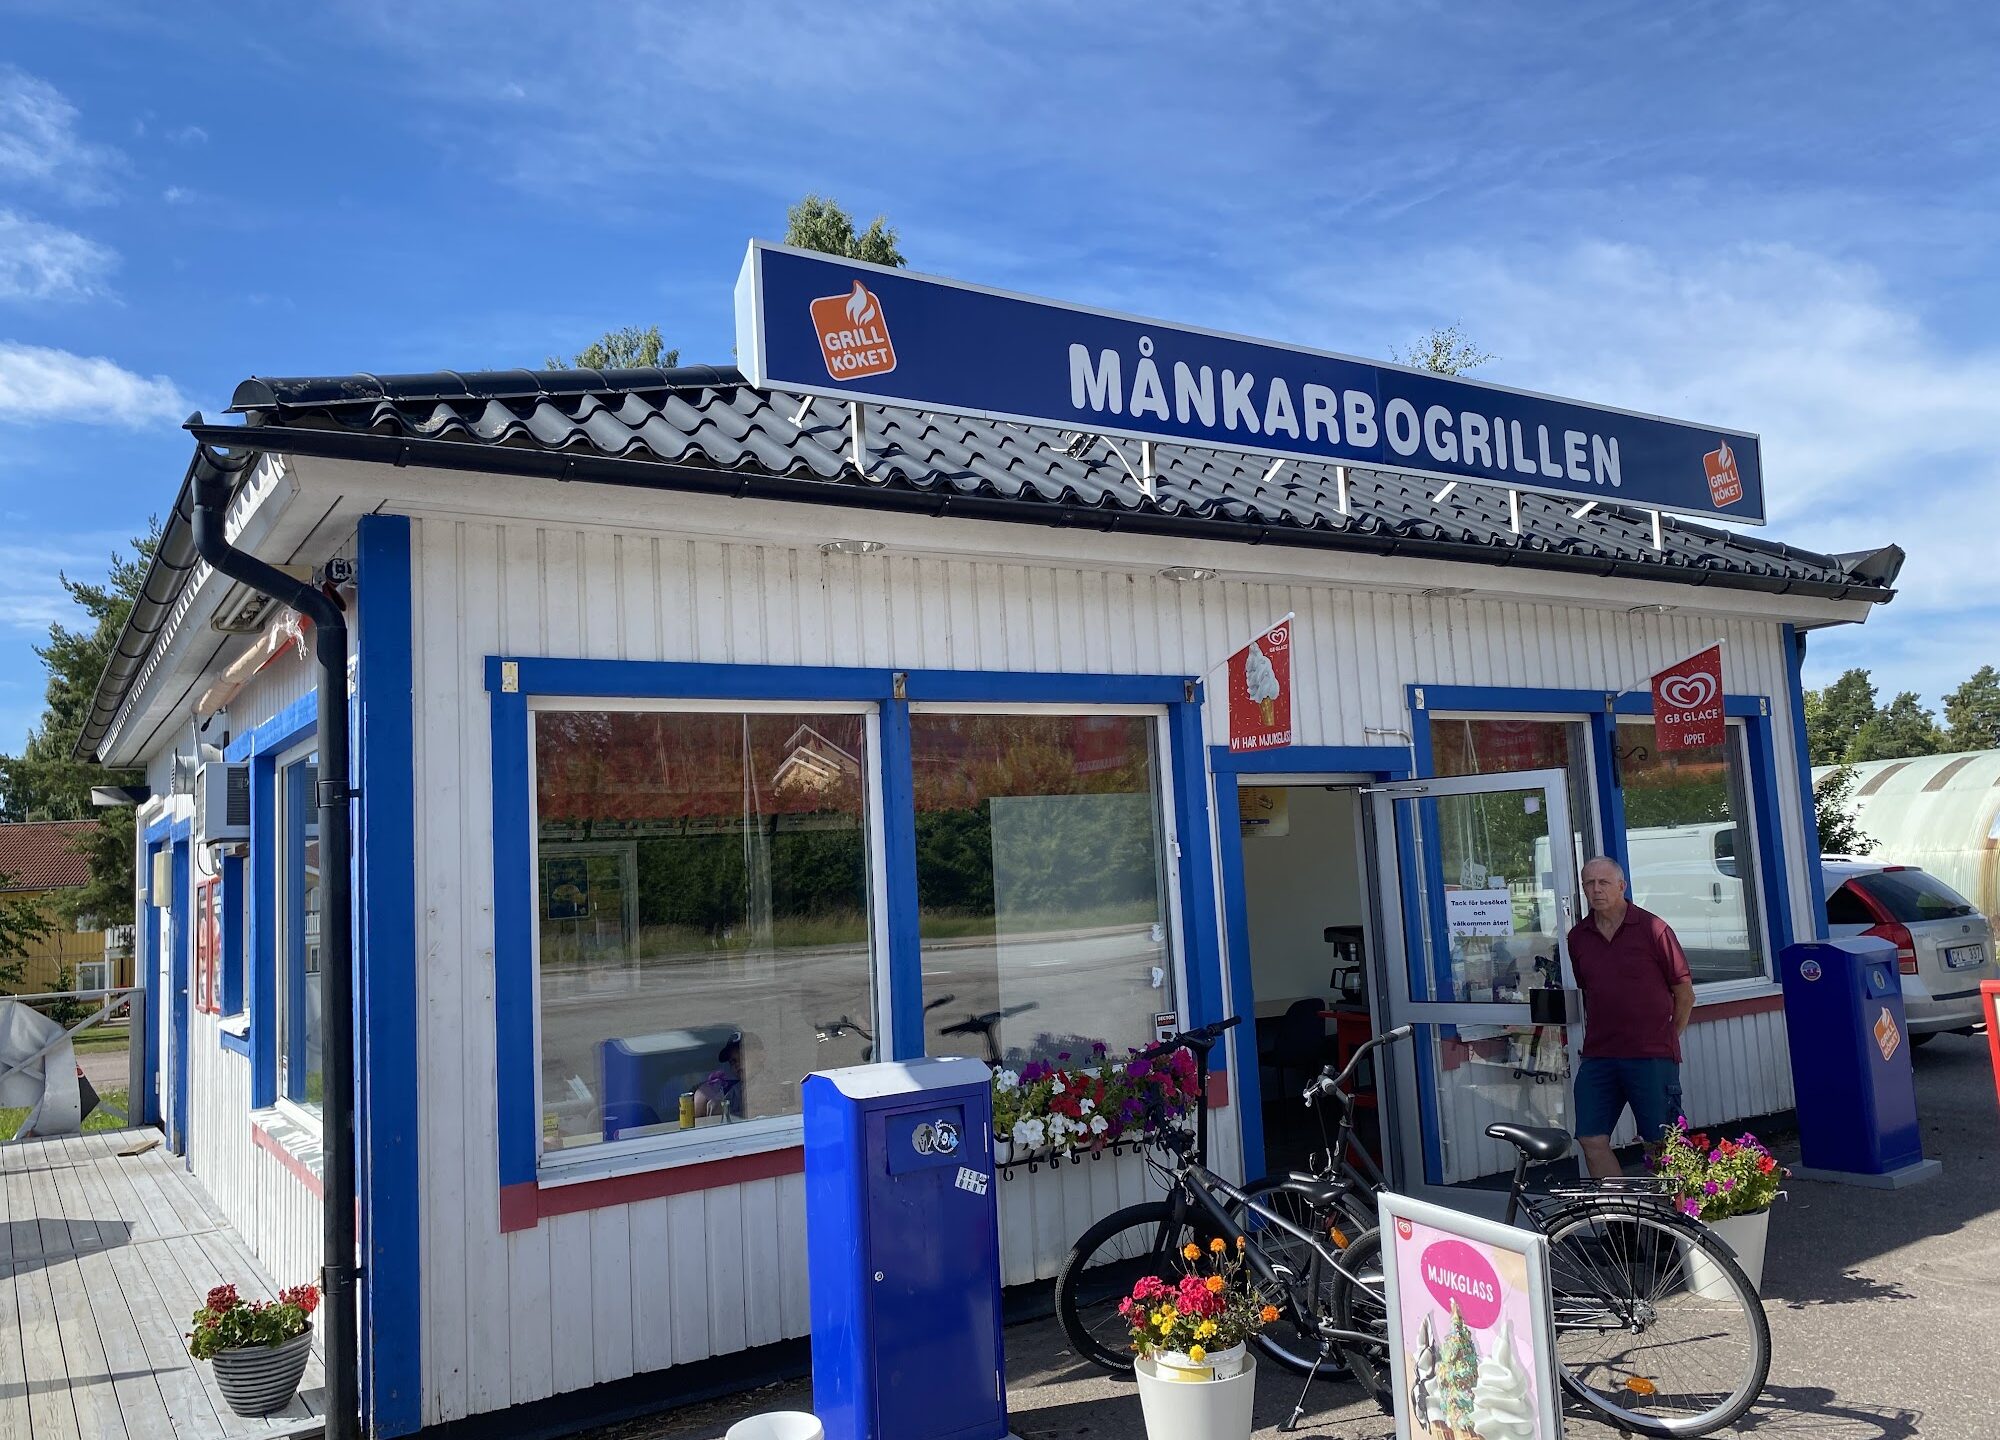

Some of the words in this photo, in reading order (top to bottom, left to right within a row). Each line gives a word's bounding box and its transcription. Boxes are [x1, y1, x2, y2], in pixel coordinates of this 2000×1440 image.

[825, 326, 885, 351] GRILL
[831, 349, 888, 372] KÖKET
[1068, 335, 1622, 488] MÅNKARBOGRILLEN
[1710, 469, 1737, 488] GRILL
[1713, 483, 1739, 502] KÖKET
[1664, 713, 1680, 724] GB
[1683, 708, 1718, 722] GLACE
[1242, 735, 1258, 749] HAR
[1683, 732, 1706, 745] ÖPPET
[1427, 1263, 1495, 1303] MJUKGLASS
